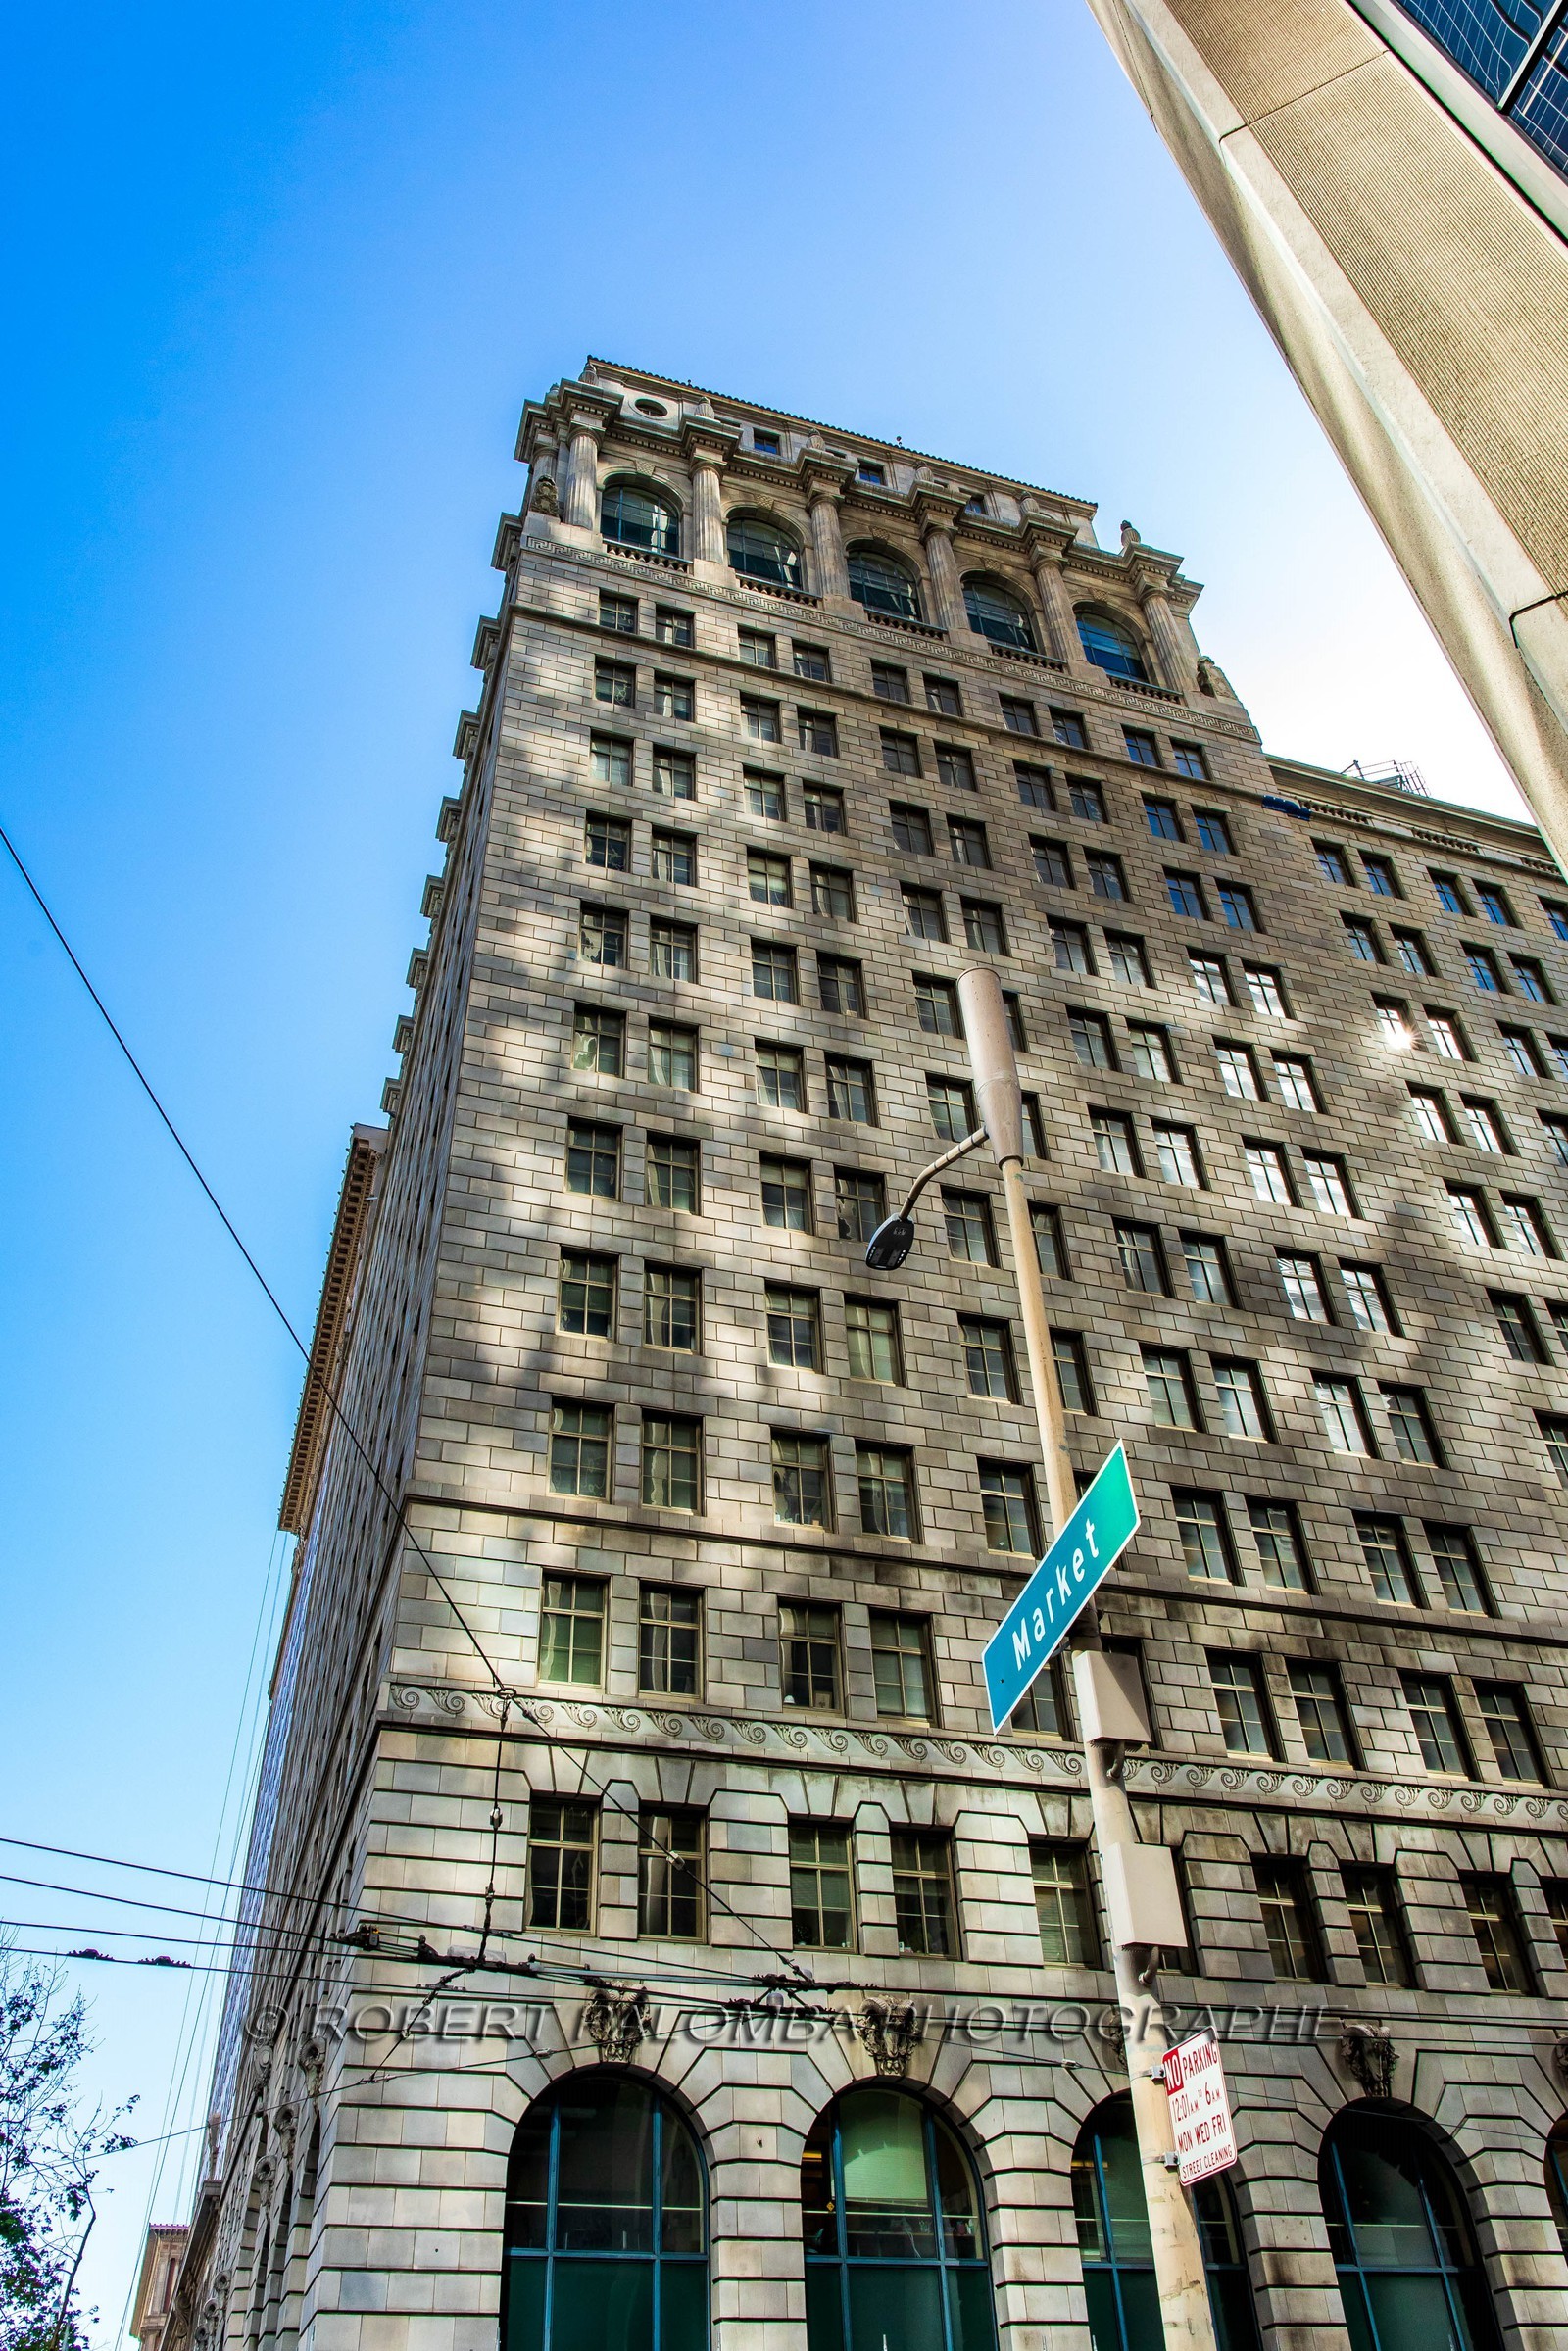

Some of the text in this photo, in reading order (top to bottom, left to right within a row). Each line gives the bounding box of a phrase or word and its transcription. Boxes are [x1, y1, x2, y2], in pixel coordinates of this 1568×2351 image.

[1010, 1518, 1100, 1671] Market
[1164, 2041, 1218, 2091] NO PARKING
[1178, 2112, 1227, 2154] MON WED FRI
[1182, 2144, 1233, 2179] STREET CLEANING
